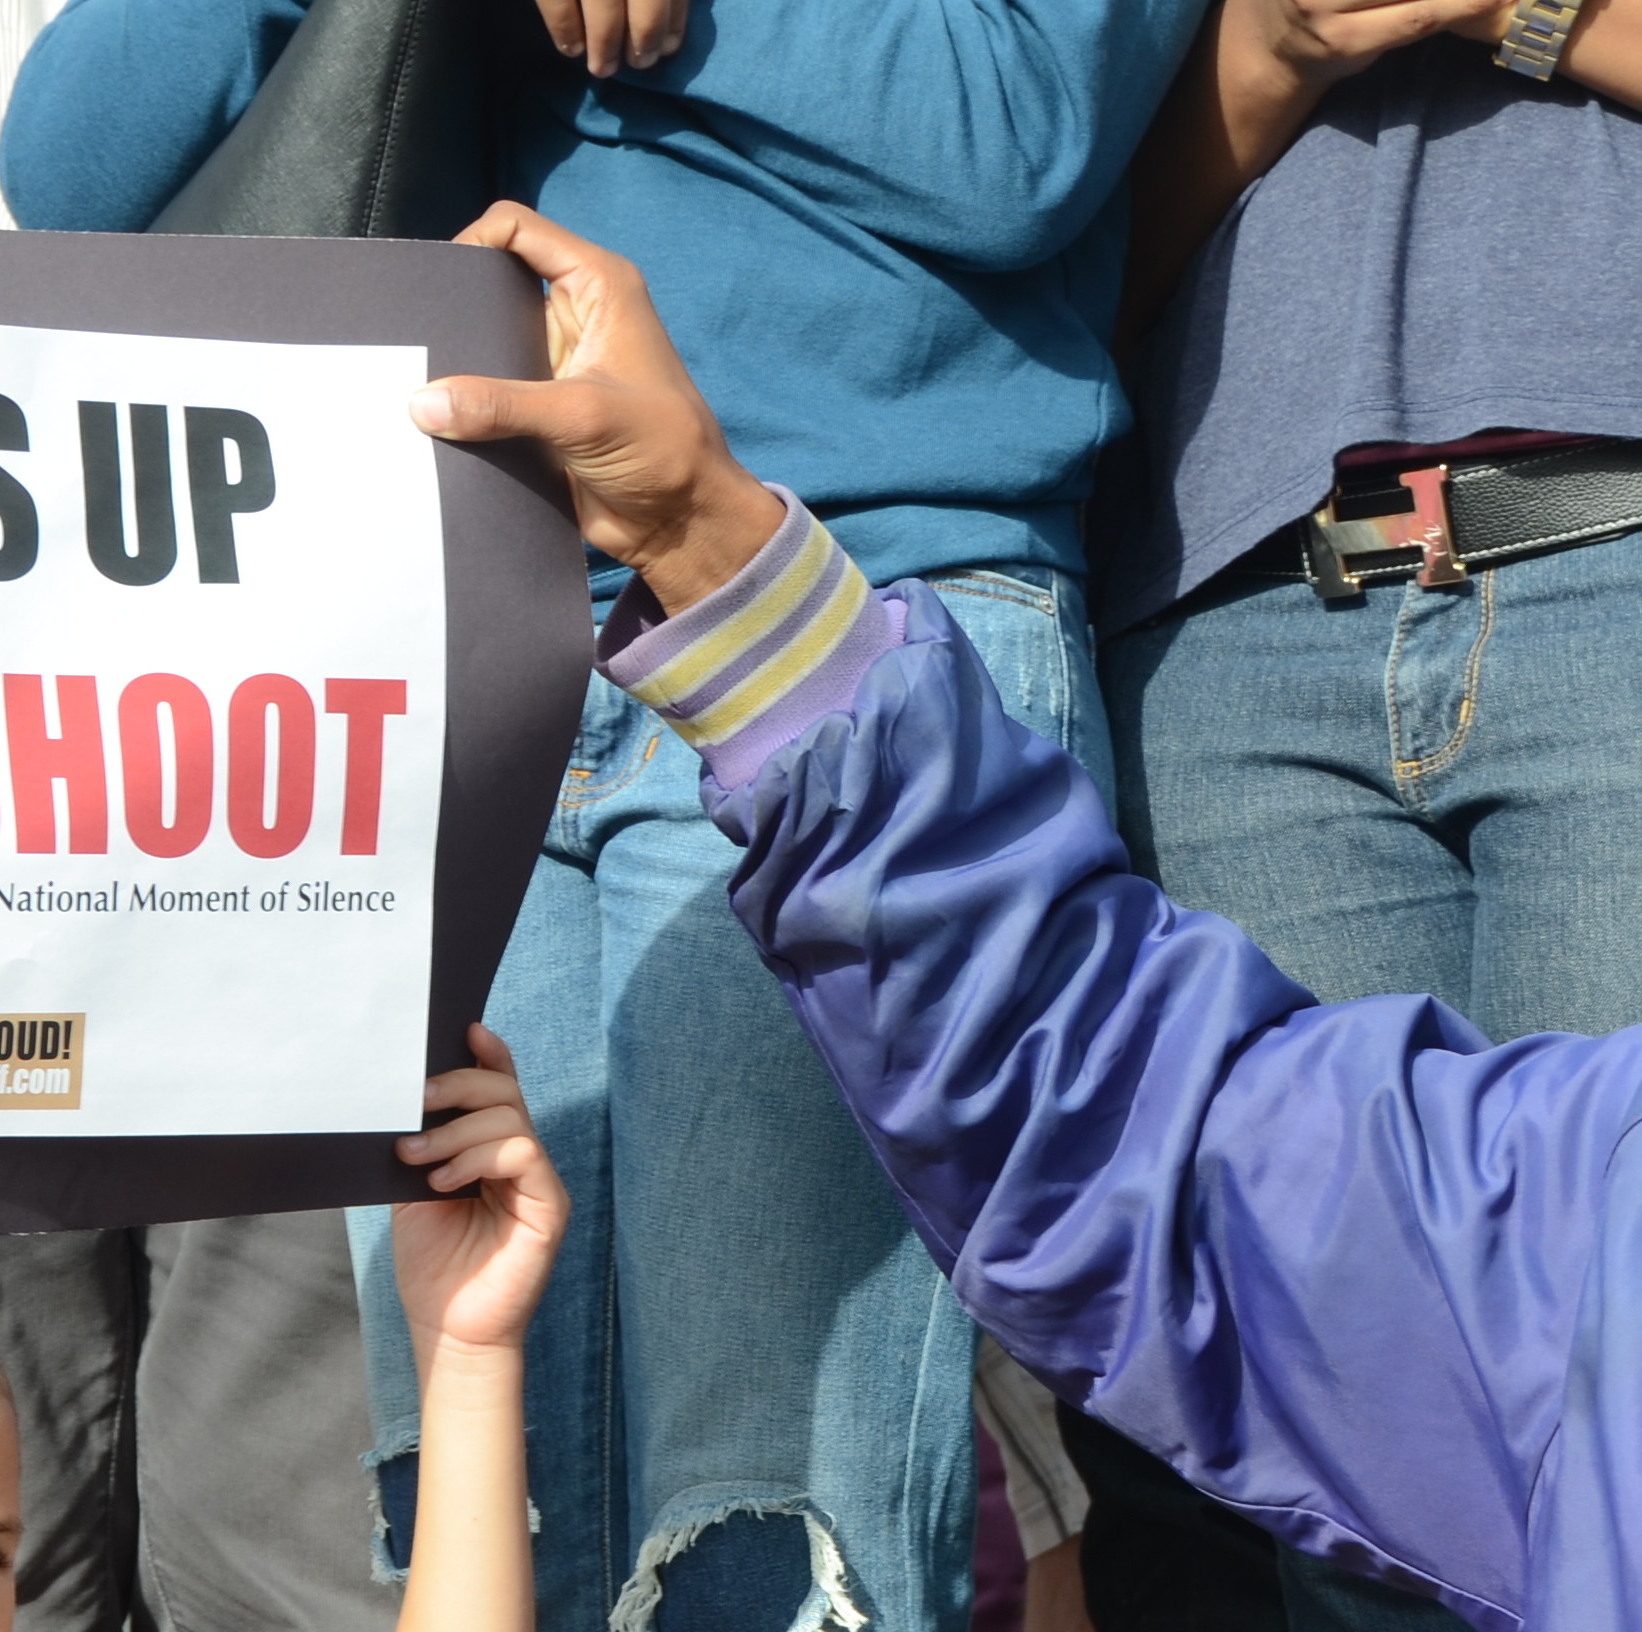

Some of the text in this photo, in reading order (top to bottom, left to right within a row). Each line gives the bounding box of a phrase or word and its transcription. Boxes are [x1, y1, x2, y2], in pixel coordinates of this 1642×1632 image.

[78, 400, 276, 587] UP
[129, 883, 251, 913] Moment
[259, 880, 291, 913] of
[296, 880, 396, 913] Silence
